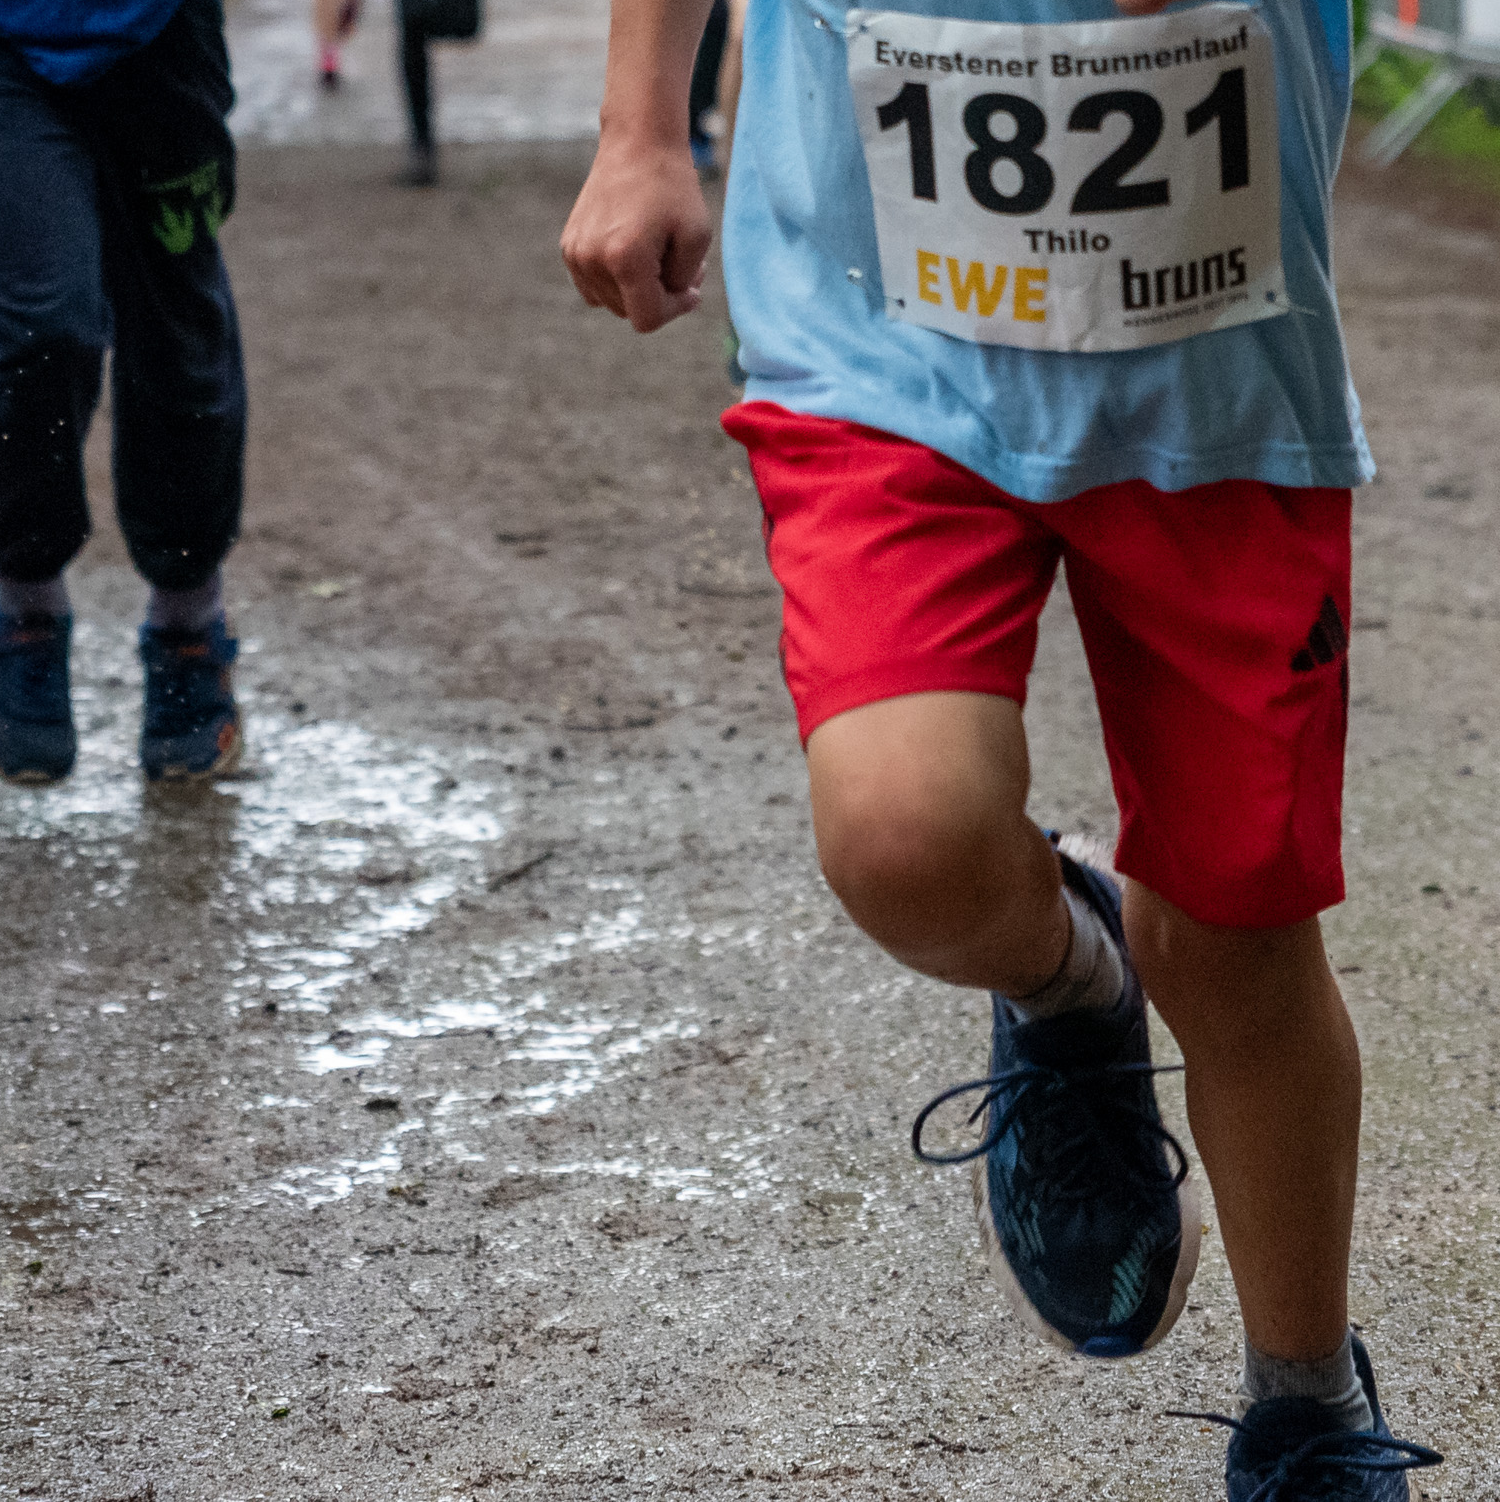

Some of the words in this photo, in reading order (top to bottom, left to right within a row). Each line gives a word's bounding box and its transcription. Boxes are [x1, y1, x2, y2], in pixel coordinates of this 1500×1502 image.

[874, 39, 1039, 78] Everstener
[1051, 26, 1249, 78] Brunnenlauf
[875, 66, 1250, 216] 1821
[1023, 229, 1111, 255] Thilo
[916, 249, 1049, 323] EWE
[1120, 246, 1247, 311] bruns
